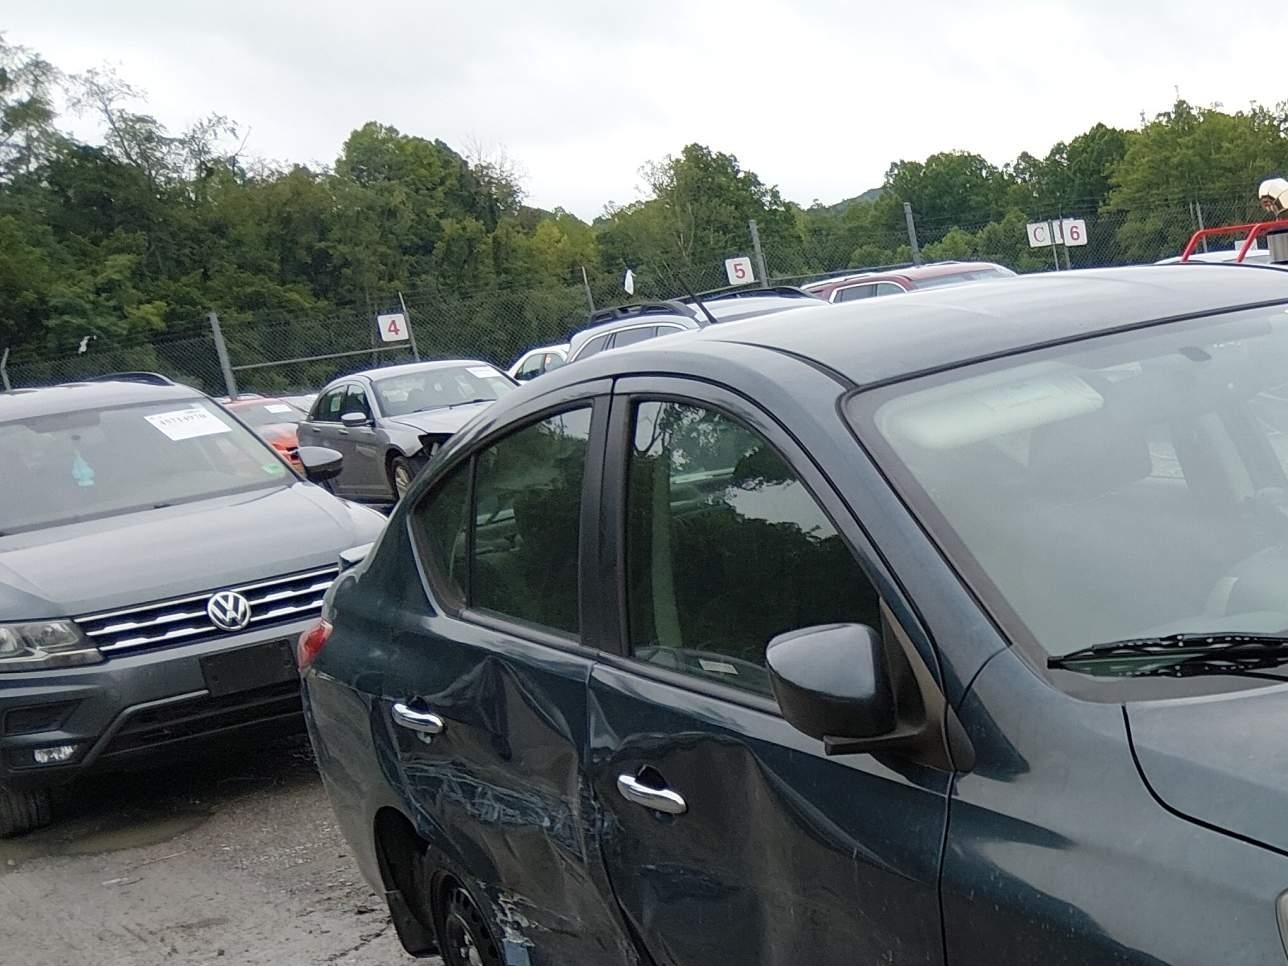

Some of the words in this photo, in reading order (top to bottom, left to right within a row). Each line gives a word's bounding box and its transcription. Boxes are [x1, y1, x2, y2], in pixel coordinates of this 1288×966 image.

[1033, 226, 1046, 243] C
[1070, 225, 1080, 241] 6
[733, 262, 746, 279] 5
[388, 319, 400, 335] 4
[208, 591, 250, 630] VW
